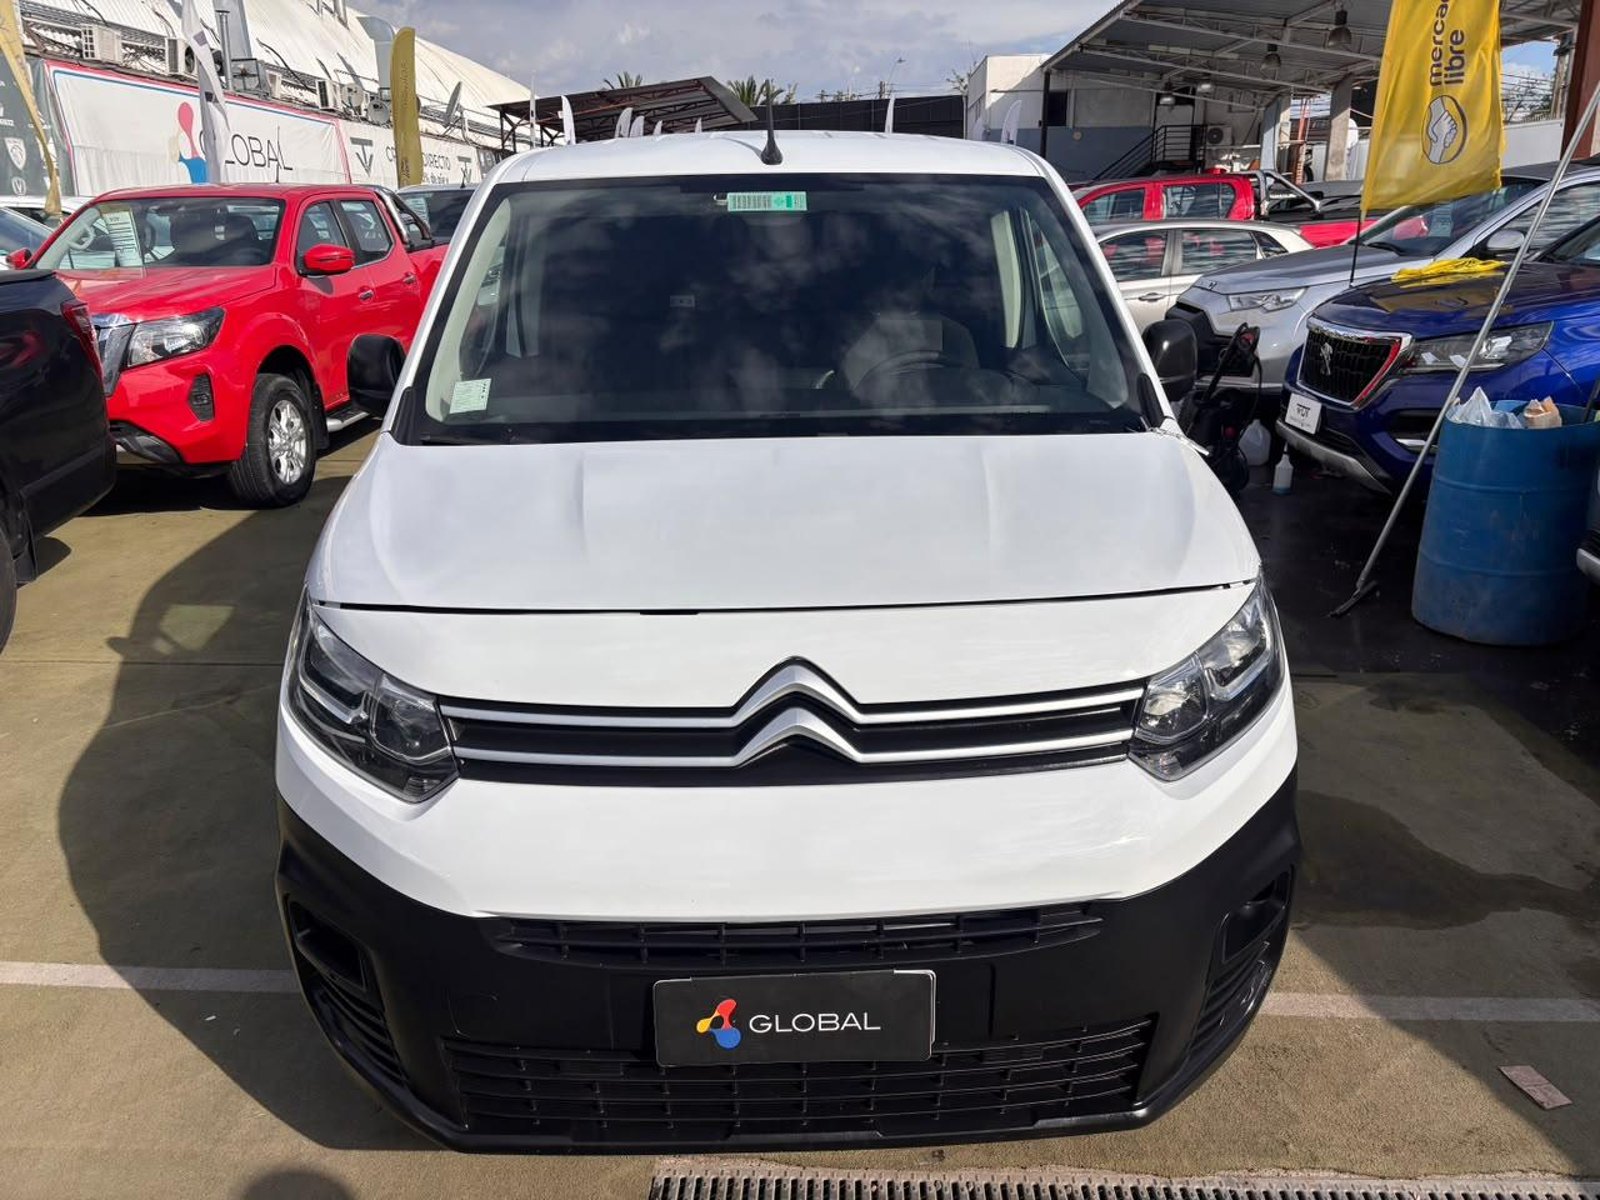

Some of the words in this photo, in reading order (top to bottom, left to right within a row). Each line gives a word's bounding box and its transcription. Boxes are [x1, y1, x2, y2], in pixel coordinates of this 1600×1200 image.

[1430, 0, 1449, 86] merca
[1444, 29, 1465, 84] libre
[749, 1012, 881, 1033] GLOBAL
